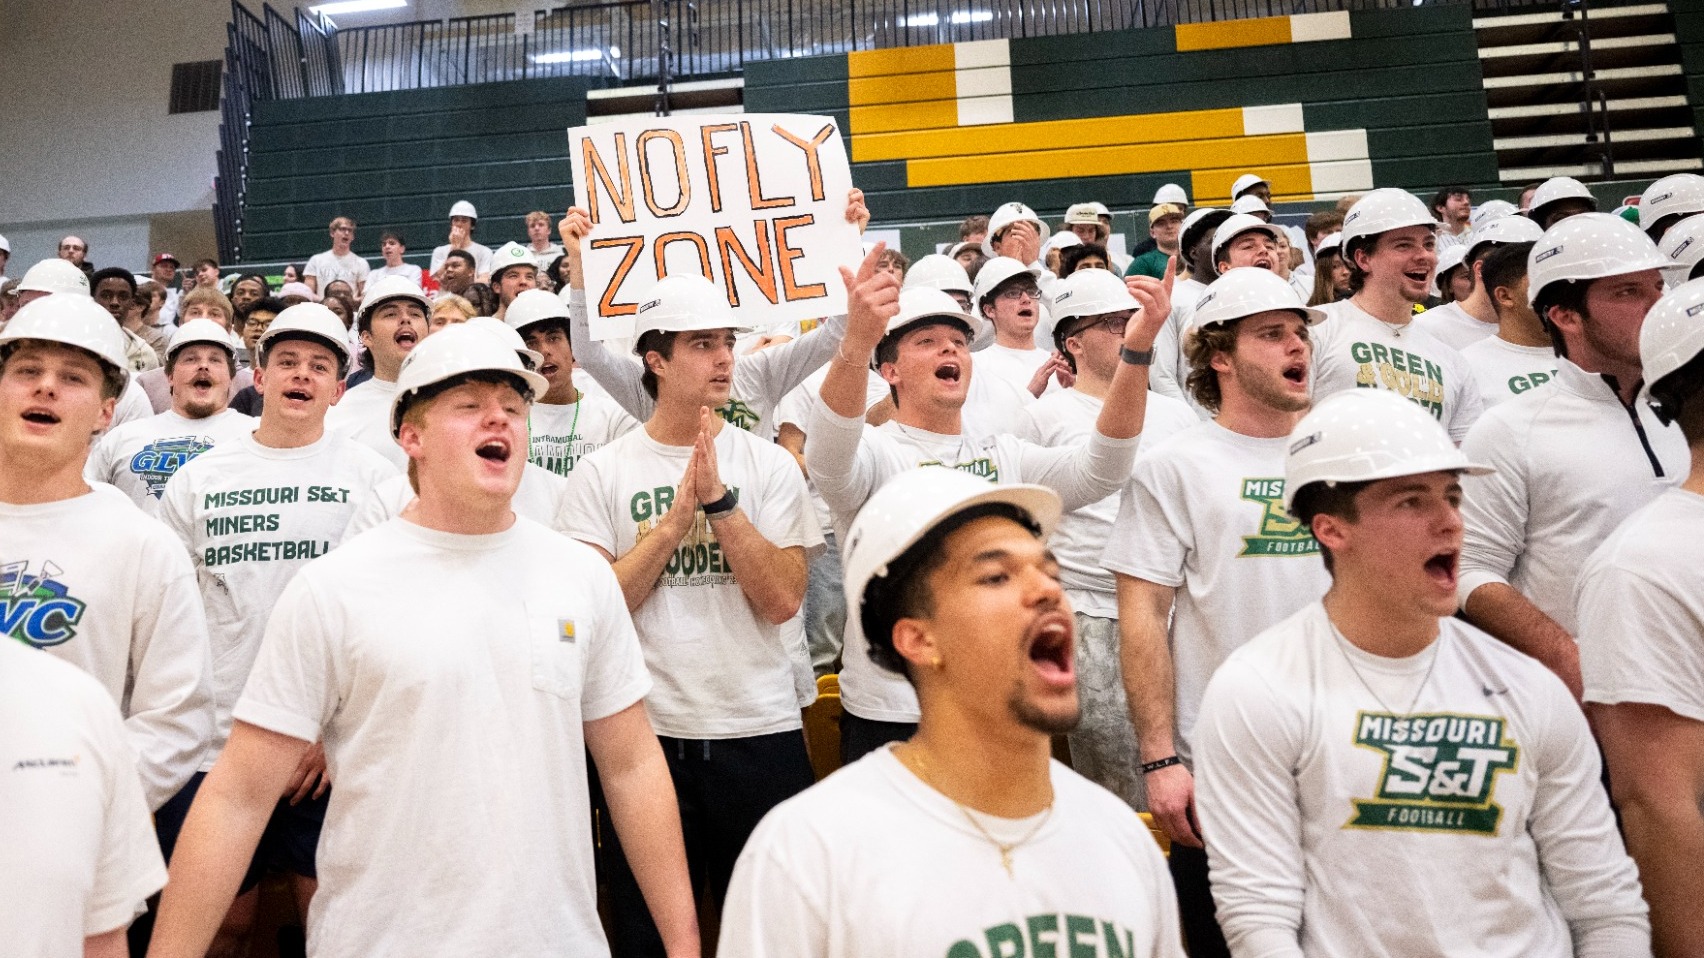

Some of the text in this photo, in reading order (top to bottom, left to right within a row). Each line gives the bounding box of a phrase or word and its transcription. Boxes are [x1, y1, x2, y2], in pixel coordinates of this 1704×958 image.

[581, 121, 836, 225] NO FLY
[591, 213, 829, 318] ZONE
[1351, 341, 1443, 386] GREEN
[532, 433, 583, 444] INTRAMURAL
[204, 485, 350, 510] MISSOURI S&T
[1245, 481, 1284, 497] MIS
[206, 513, 280, 538] MINERS
[1266, 540, 1321, 552] FOOTBAL
[1358, 715, 1499, 746] MISSOURI
[1382, 744, 1510, 798] S&T
[1387, 807, 1465, 826] FOOTBALL
